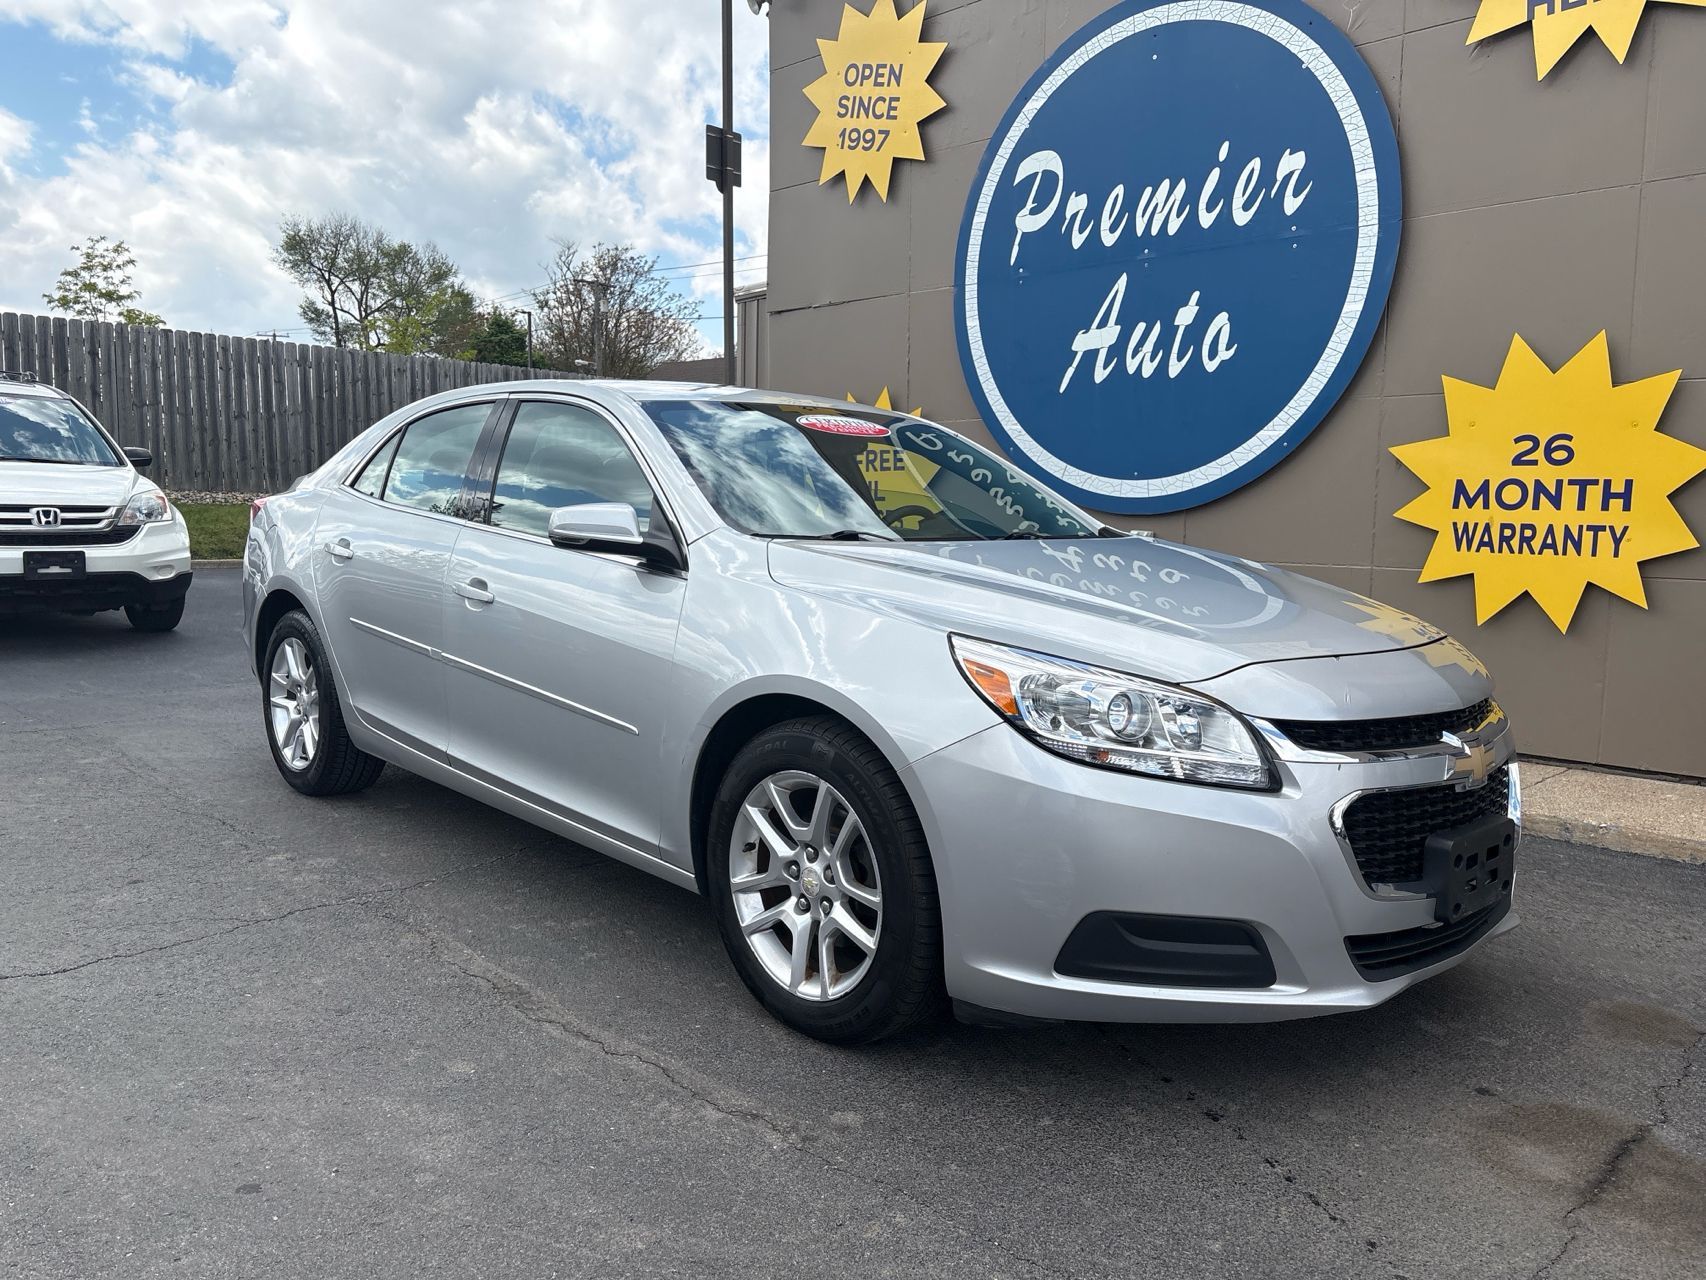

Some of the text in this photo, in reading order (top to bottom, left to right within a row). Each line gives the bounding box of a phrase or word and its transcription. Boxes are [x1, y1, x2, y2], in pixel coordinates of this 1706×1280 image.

[844, 63, 904, 88] OPEN
[836, 94, 901, 120] SINCE
[839, 127, 891, 152] 1997
[1010, 140, 1313, 266] Premier
[1059, 271, 1238, 394] Auto
[1511, 433, 1575, 467] 26
[1451, 478, 1634, 512] MONTH
[1452, 521, 1630, 559] WARRANTY
